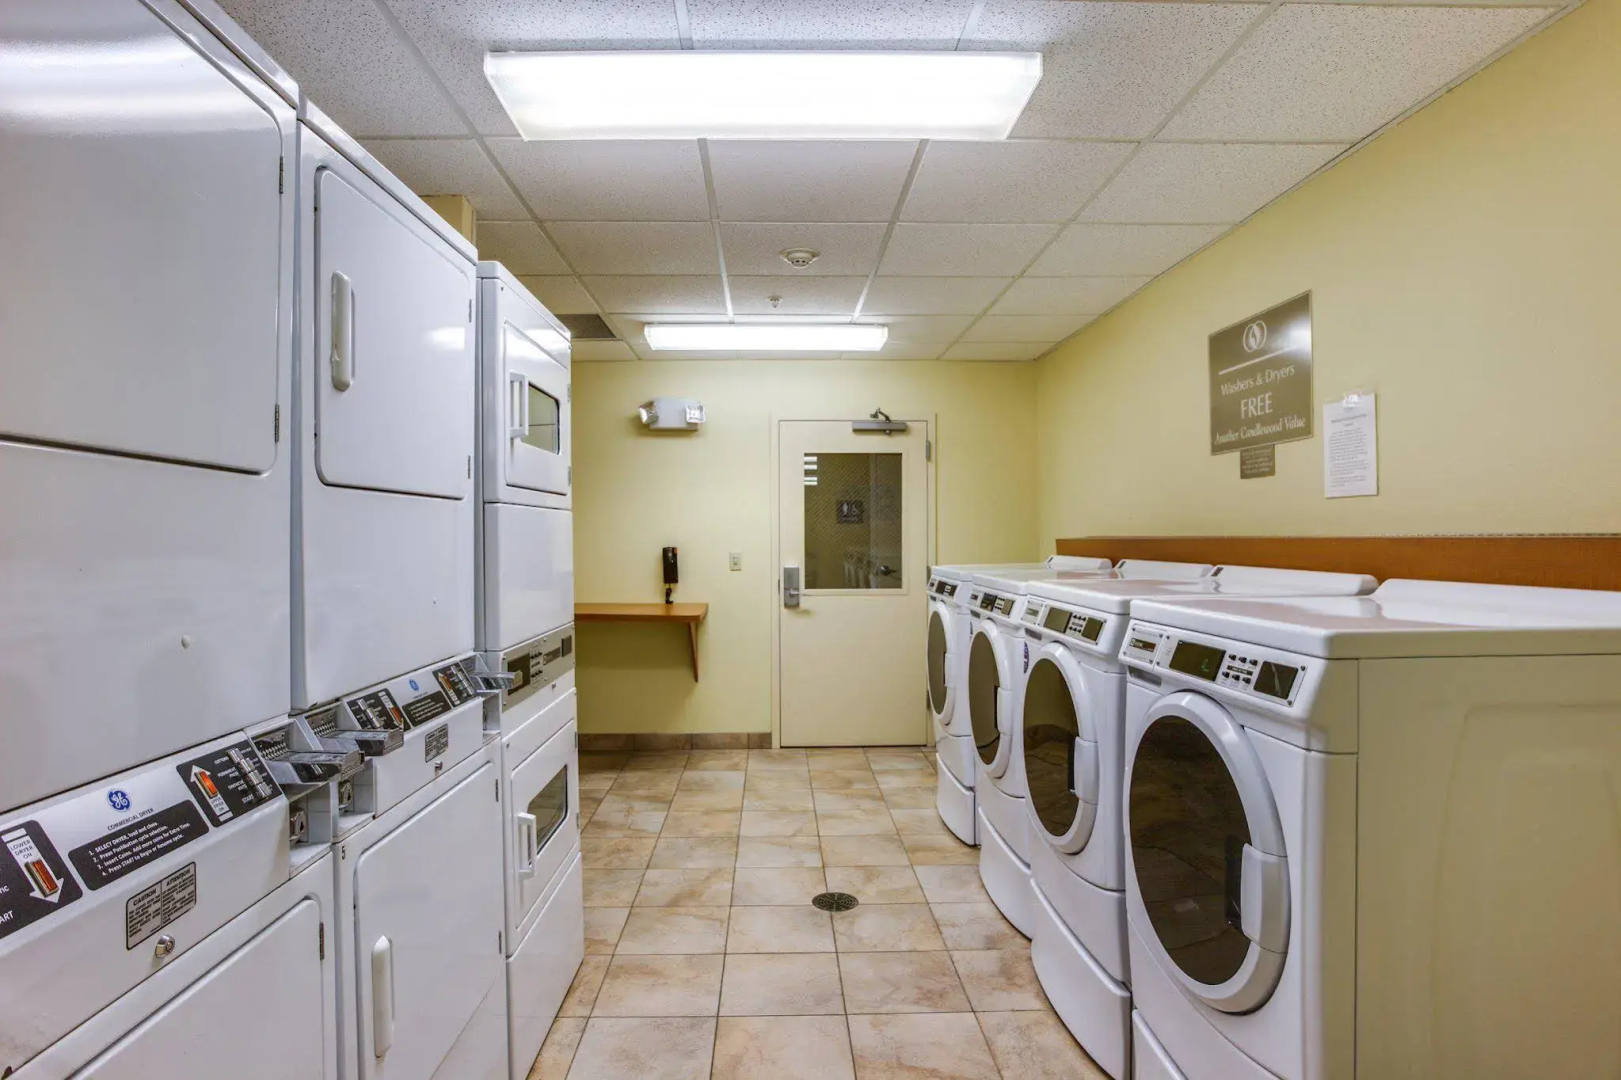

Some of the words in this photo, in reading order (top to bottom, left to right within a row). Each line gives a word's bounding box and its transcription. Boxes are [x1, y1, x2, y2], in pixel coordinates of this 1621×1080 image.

[1220, 376, 1254, 396] Washers
[1256, 373, 1266, 387] &
[1265, 364, 1295, 387] Dryers
[1240, 391, 1273, 420] FREE
[1214, 427, 1240, 445] Another
[1240, 418, 1283, 440] Candlewood
[1284, 414, 1306, 430] Value
[107, 815, 140, 831] COMMERCIAL
[139, 808, 154, 818] DRYER
[10, 839, 31, 851] LOWER
[95, 841, 113, 853] SELECT
[129, 830, 138, 839] load
[138, 825, 147, 834] and
[146, 821, 159, 830] close.
[100, 849, 113, 860] Press
[113, 838, 139, 854] Pushbutton
[138, 833, 149, 842] cycle
[149, 825, 168, 838] selection.
[104, 856, 118, 867] Insert
[132, 846, 142, 854] Add
[179, 822, 191, 831] Time.
[14, 845, 34, 856] DRYER
[23, 852, 33, 860] ON
[108, 863, 122, 874] Press
[121, 857, 135, 868] START
[140, 850, 153, 862] Begin
[172, 833, 184, 843] cycle.
[341, 845, 346, 860] 5
[166, 868, 191, 887] ATTENTION
[133, 888, 157, 906] CAUTION
